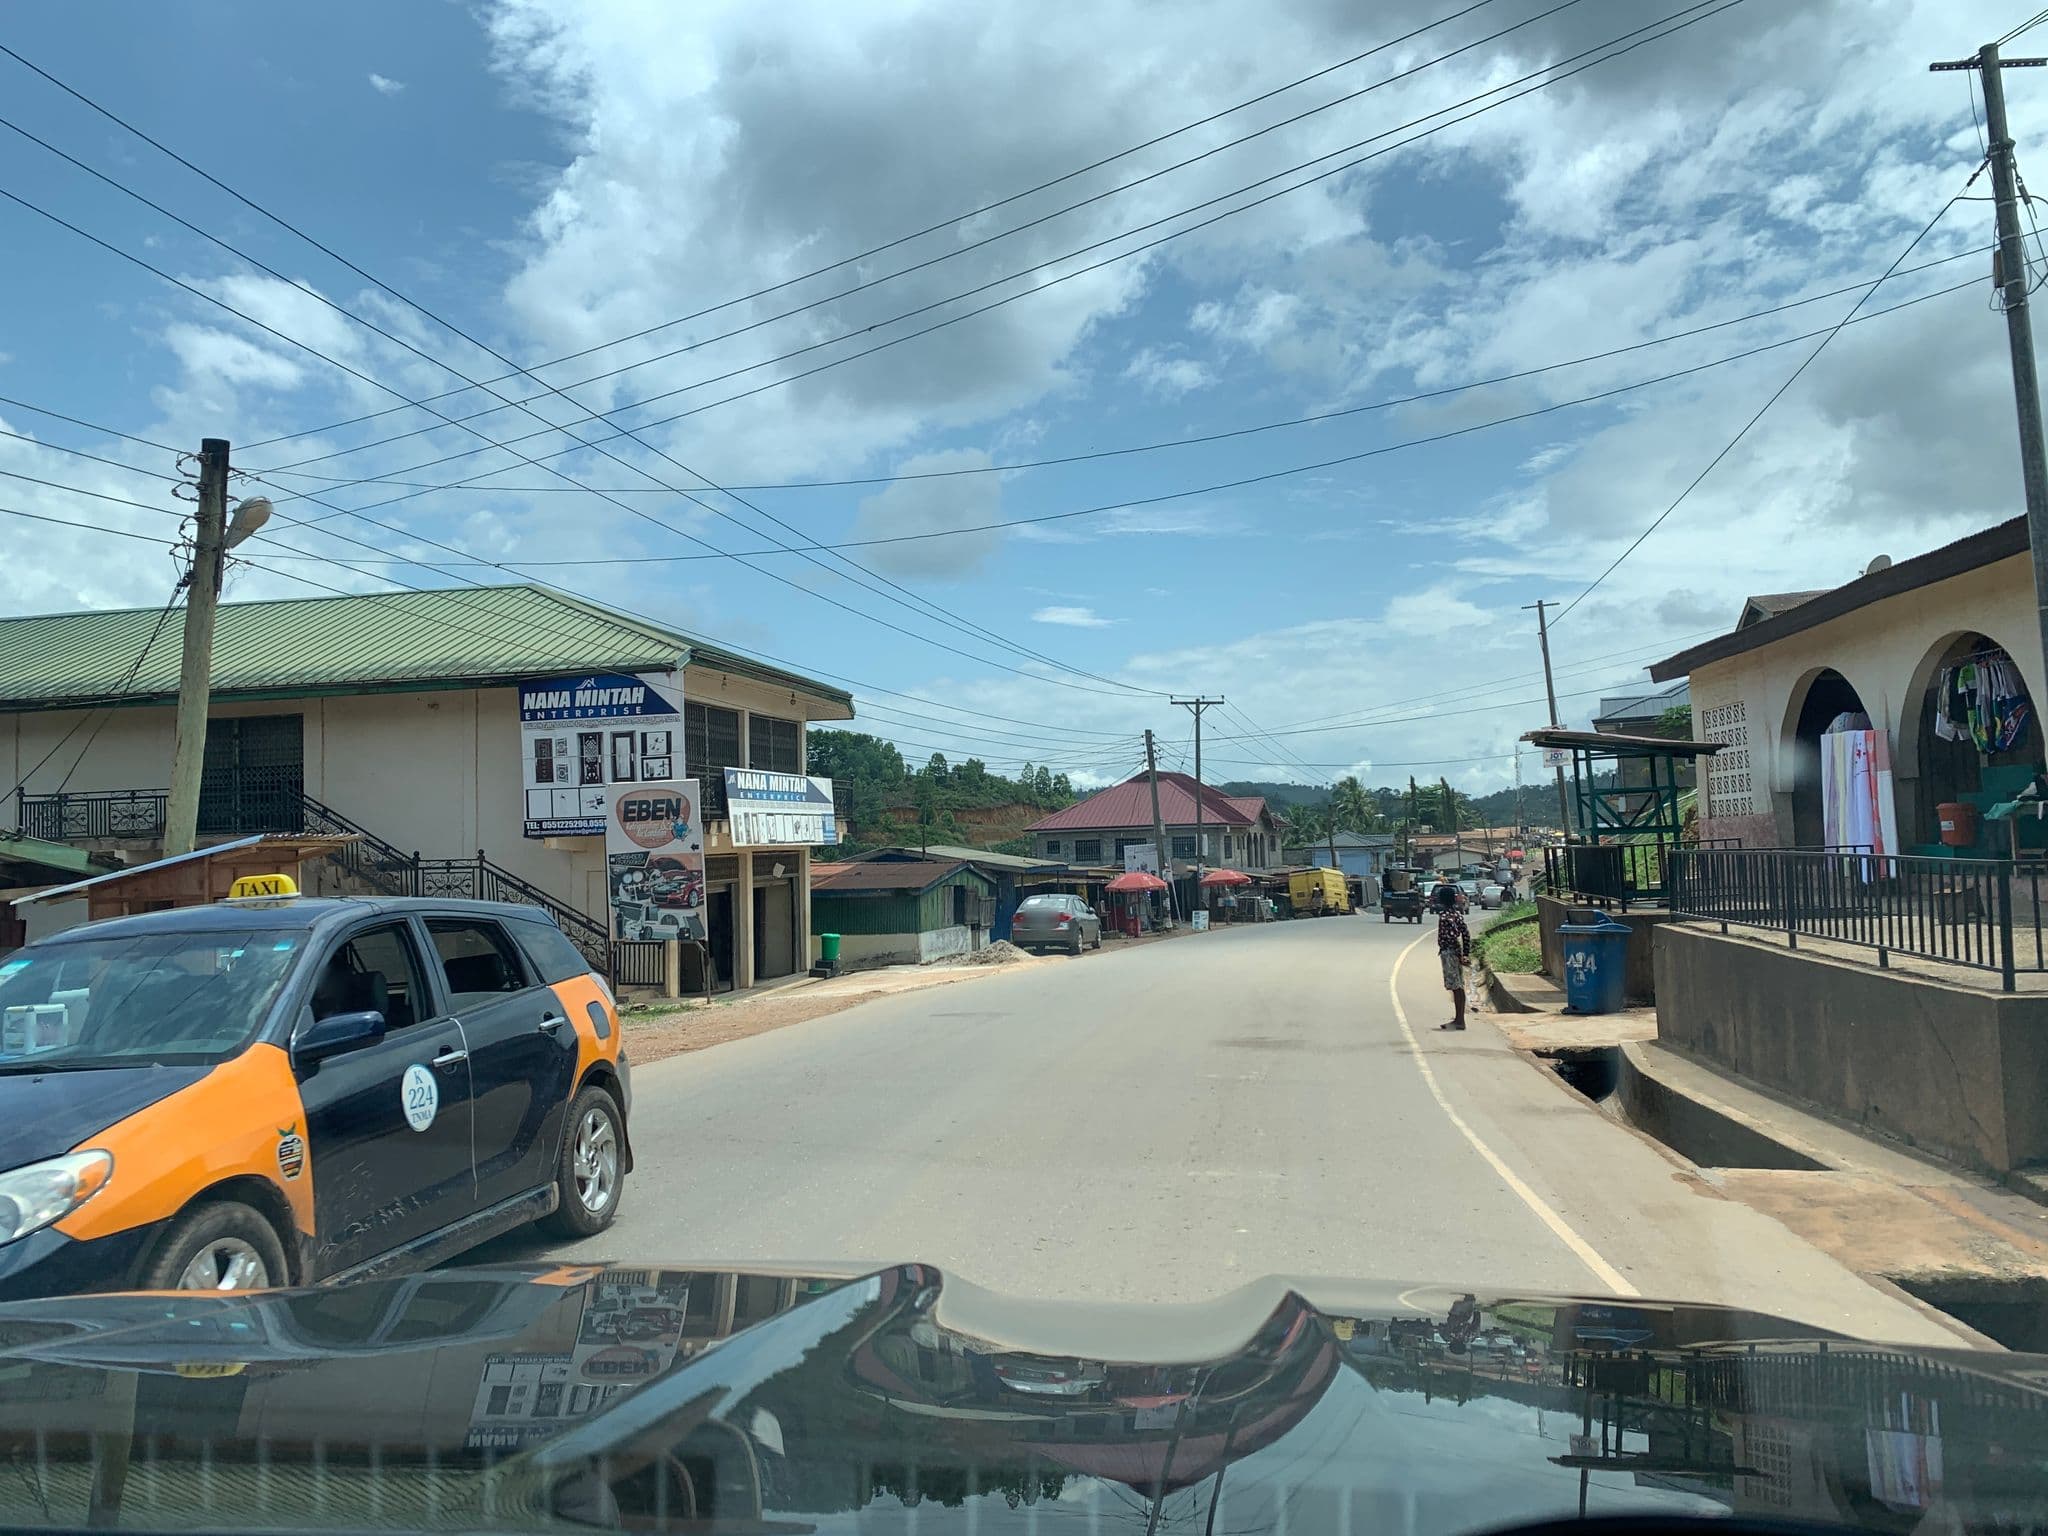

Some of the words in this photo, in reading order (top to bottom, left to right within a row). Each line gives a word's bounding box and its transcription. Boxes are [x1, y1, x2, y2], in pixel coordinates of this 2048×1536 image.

[523, 690, 570, 710] NANA
[575, 686, 645, 707] MINTAH
[525, 706, 642, 720] ENTERPRISE
[737, 771, 767, 791] NANA
[769, 774, 807, 793] MINTAH
[623, 797, 681, 822] EBEN
[525, 821, 540, 830] TEL:
[236, 880, 280, 897] TAXI
[414, 1071, 423, 1085] K
[408, 1085, 434, 1109] 224
